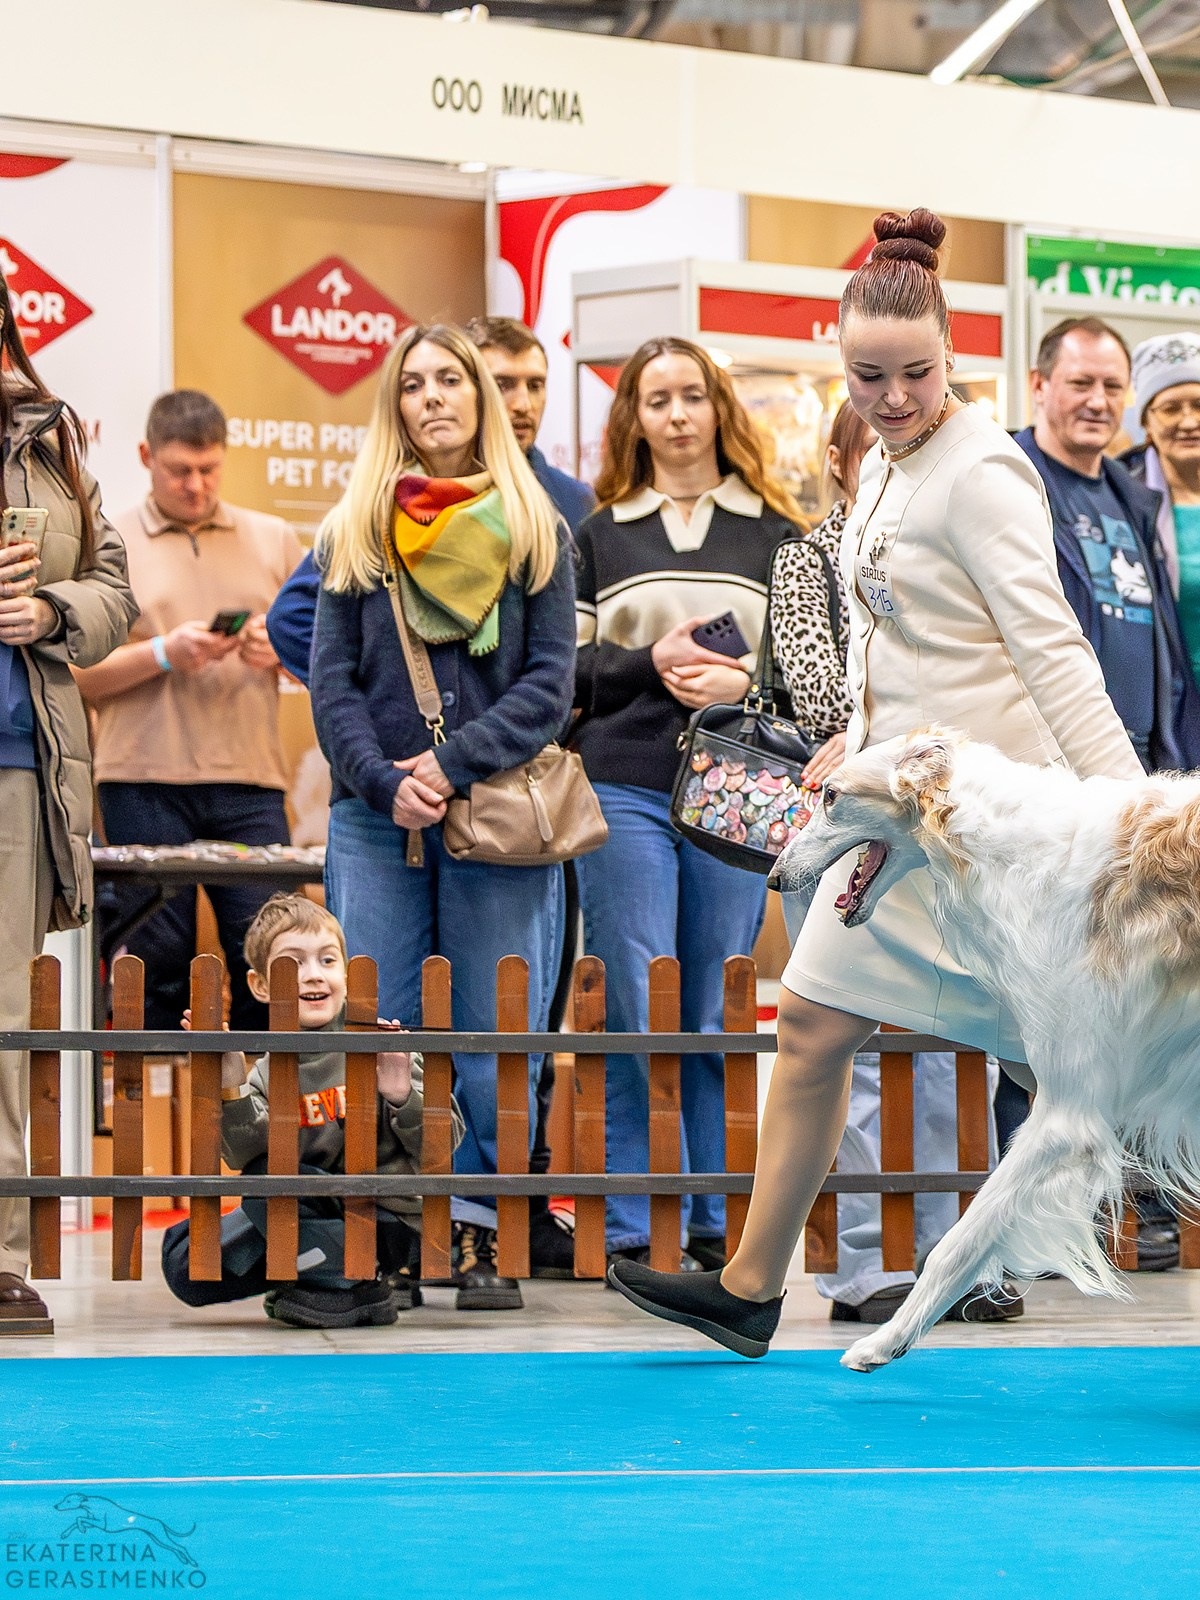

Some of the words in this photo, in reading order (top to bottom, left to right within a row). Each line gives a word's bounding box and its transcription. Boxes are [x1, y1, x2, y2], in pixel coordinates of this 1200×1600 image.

[502, 83, 584, 126] МИСМА
[271, 303, 398, 347] LANDOR
[227, 416, 315, 452] SUPER
[267, 456, 318, 489] PET
[861, 566, 886, 583] SIRIUS
[868, 586, 894, 612] 315
